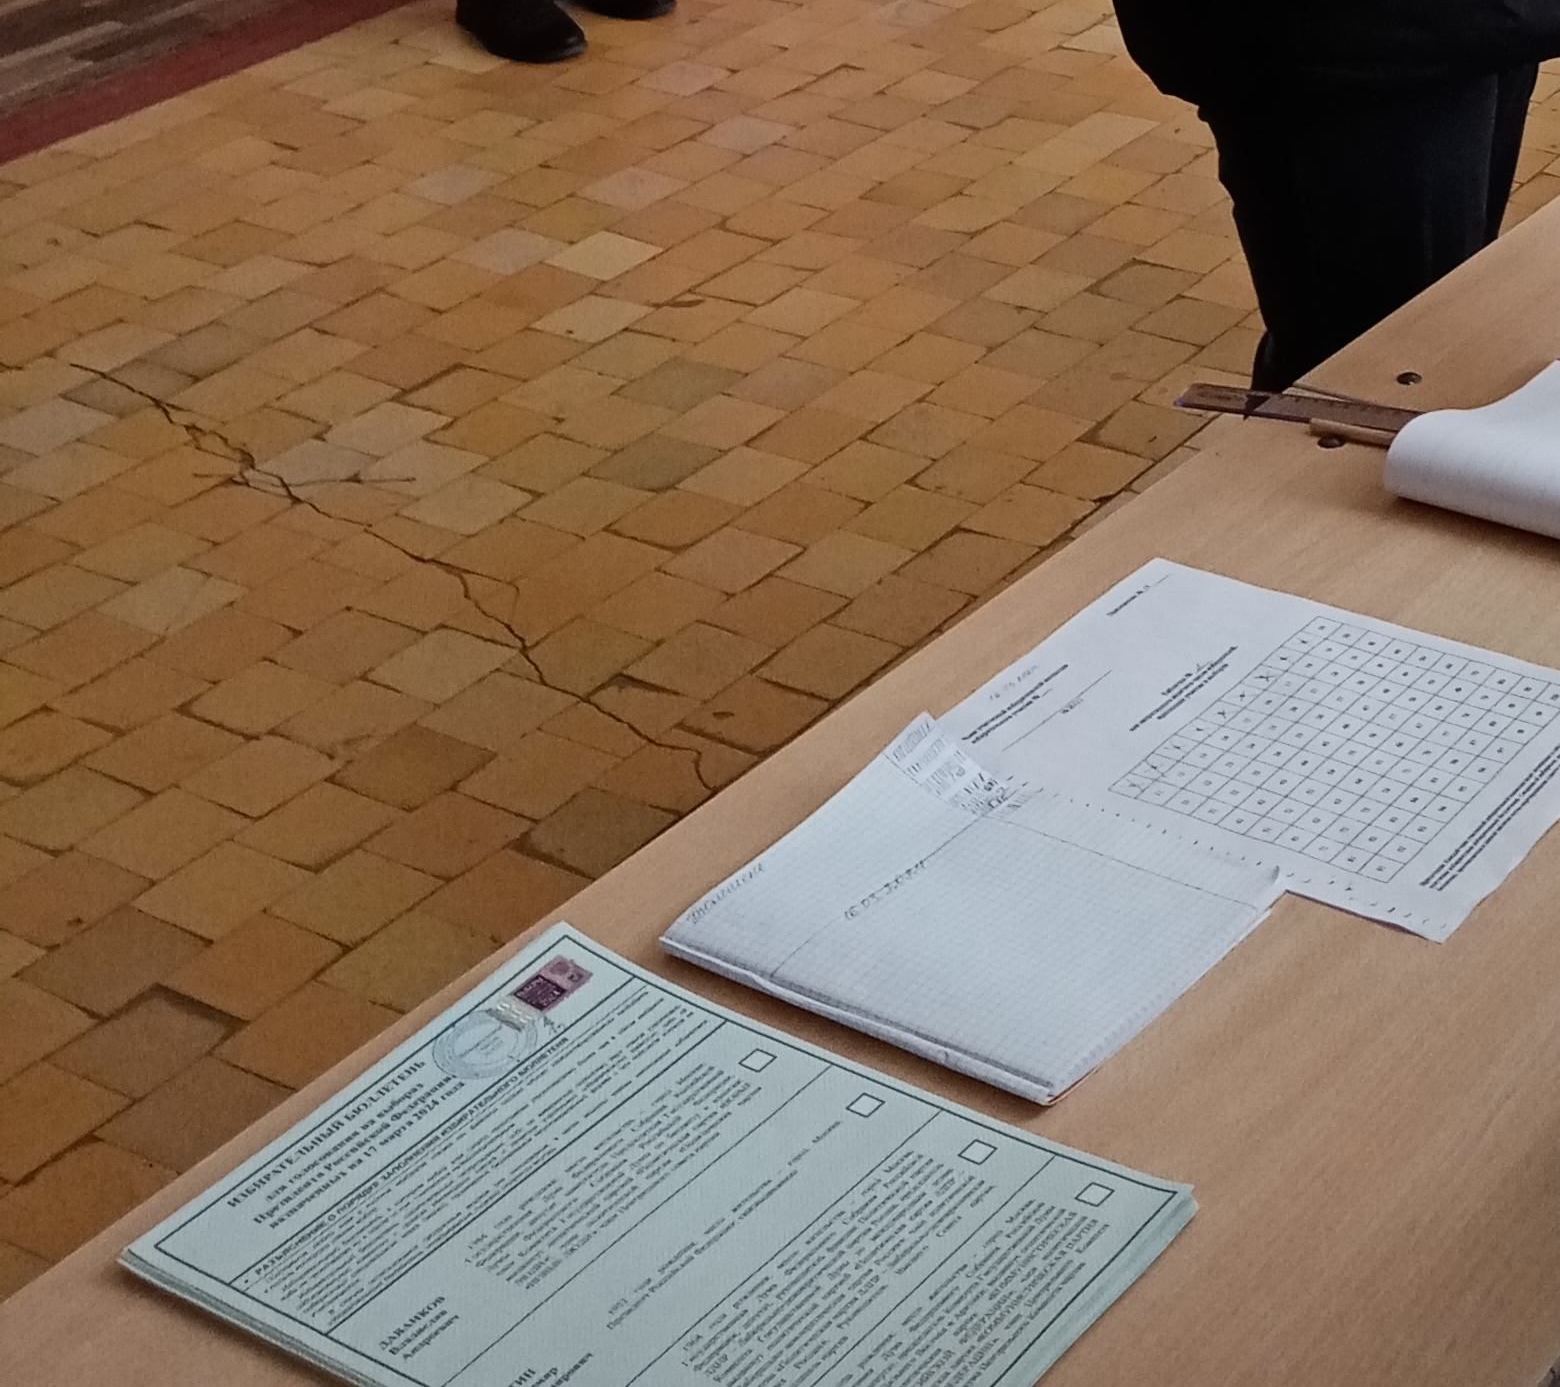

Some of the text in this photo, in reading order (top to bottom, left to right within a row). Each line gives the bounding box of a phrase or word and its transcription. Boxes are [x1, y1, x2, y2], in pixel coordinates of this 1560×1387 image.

[224, 1059, 428, 1208] ИЗБИРАТЕЛЬНЫЙ БЮЛЛЕТЕНЬ
[251, 1170, 327, 1225] Президента
[321, 1121, 393, 1171] Российской
[266, 1170, 348, 1229] назначенных
[361, 1145, 381, 1157] 17
[376, 1120, 417, 1147] марта
[410, 1099, 443, 1120] 2024
[438, 1081, 467, 1100] года
[286, 1130, 362, 1184] голосования
[372, 1081, 426, 1119] выборах
[374, 1295, 447, 1350] ДАВАНКОВ
[386, 1309, 449, 1355] Владислав
[398, 1314, 462, 1361] Андреевич
